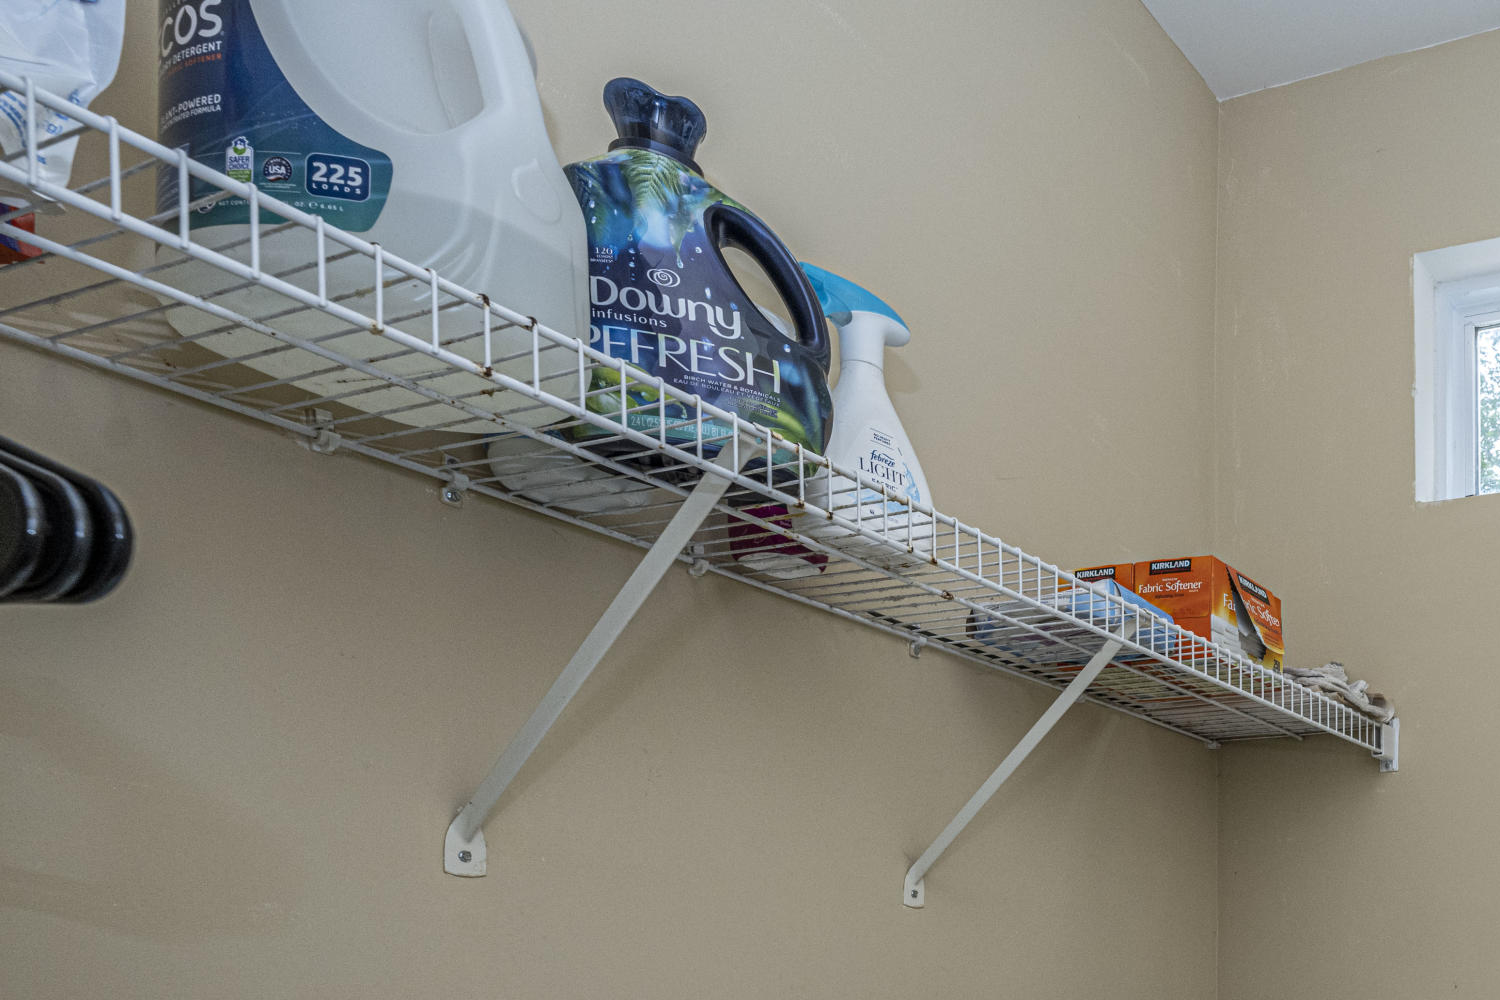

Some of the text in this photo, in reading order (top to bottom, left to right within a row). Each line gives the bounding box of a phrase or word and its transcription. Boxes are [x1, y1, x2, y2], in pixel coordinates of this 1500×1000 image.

[268, 165, 287, 175] USA
[312, 161, 363, 186] 225
[312, 184, 361, 195] LOADS
[595, 247, 613, 255] 120
[590, 275, 742, 340] Downy
[592, 307, 668, 328] infusions
[673, 378, 689, 386] EAU
[683, 374, 706, 383] BIRCH
[707, 379, 732, 389] WATER
[739, 386, 781, 403] BOTANICALS
[870, 449, 896, 467] febreze
[859, 456, 906, 486] LIGHT
[1151, 560, 1190, 570] KIRKLAND
[1076, 568, 1115, 579] KIRKLAND
[1138, 580, 1203, 594] Fabric Softener
